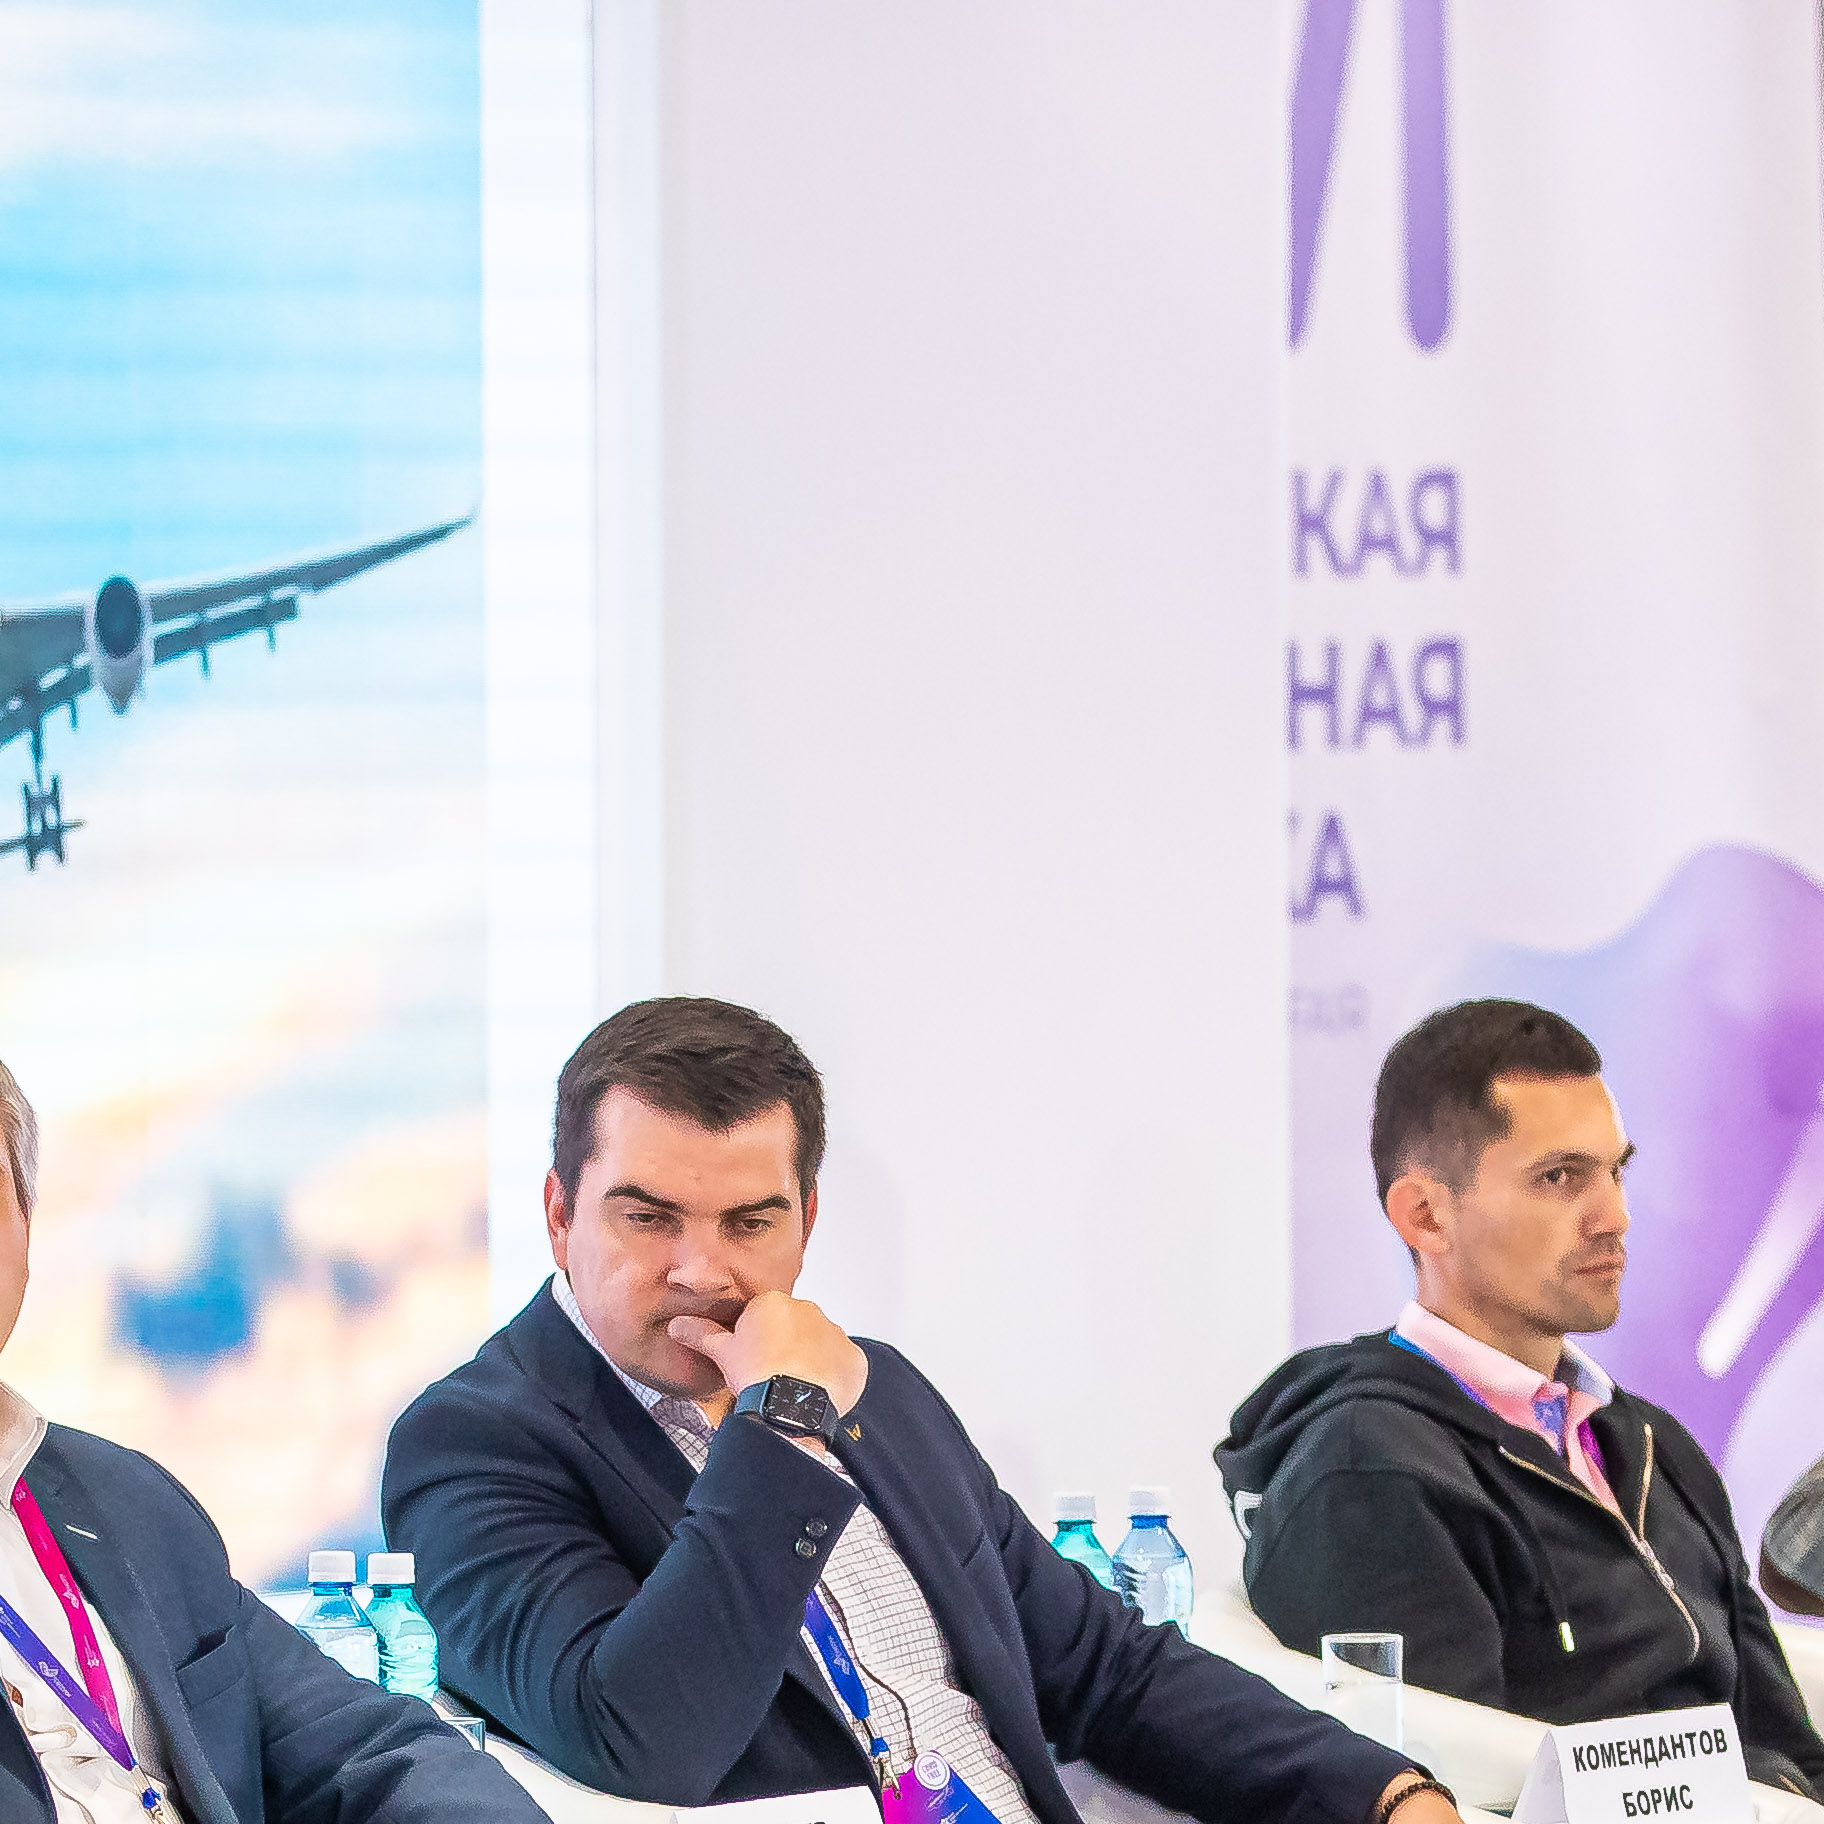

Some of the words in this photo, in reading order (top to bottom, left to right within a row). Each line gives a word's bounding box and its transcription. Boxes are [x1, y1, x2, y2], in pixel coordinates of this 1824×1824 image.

[1290, 467, 1463, 579] КАЯ
[1287, 637, 1466, 751] НАЯ
[1287, 810, 1366, 922] А
[1573, 1728, 1728, 1772] КОМЕНДАНТОВ
[1622, 1785, 1694, 1817] БОРИС
